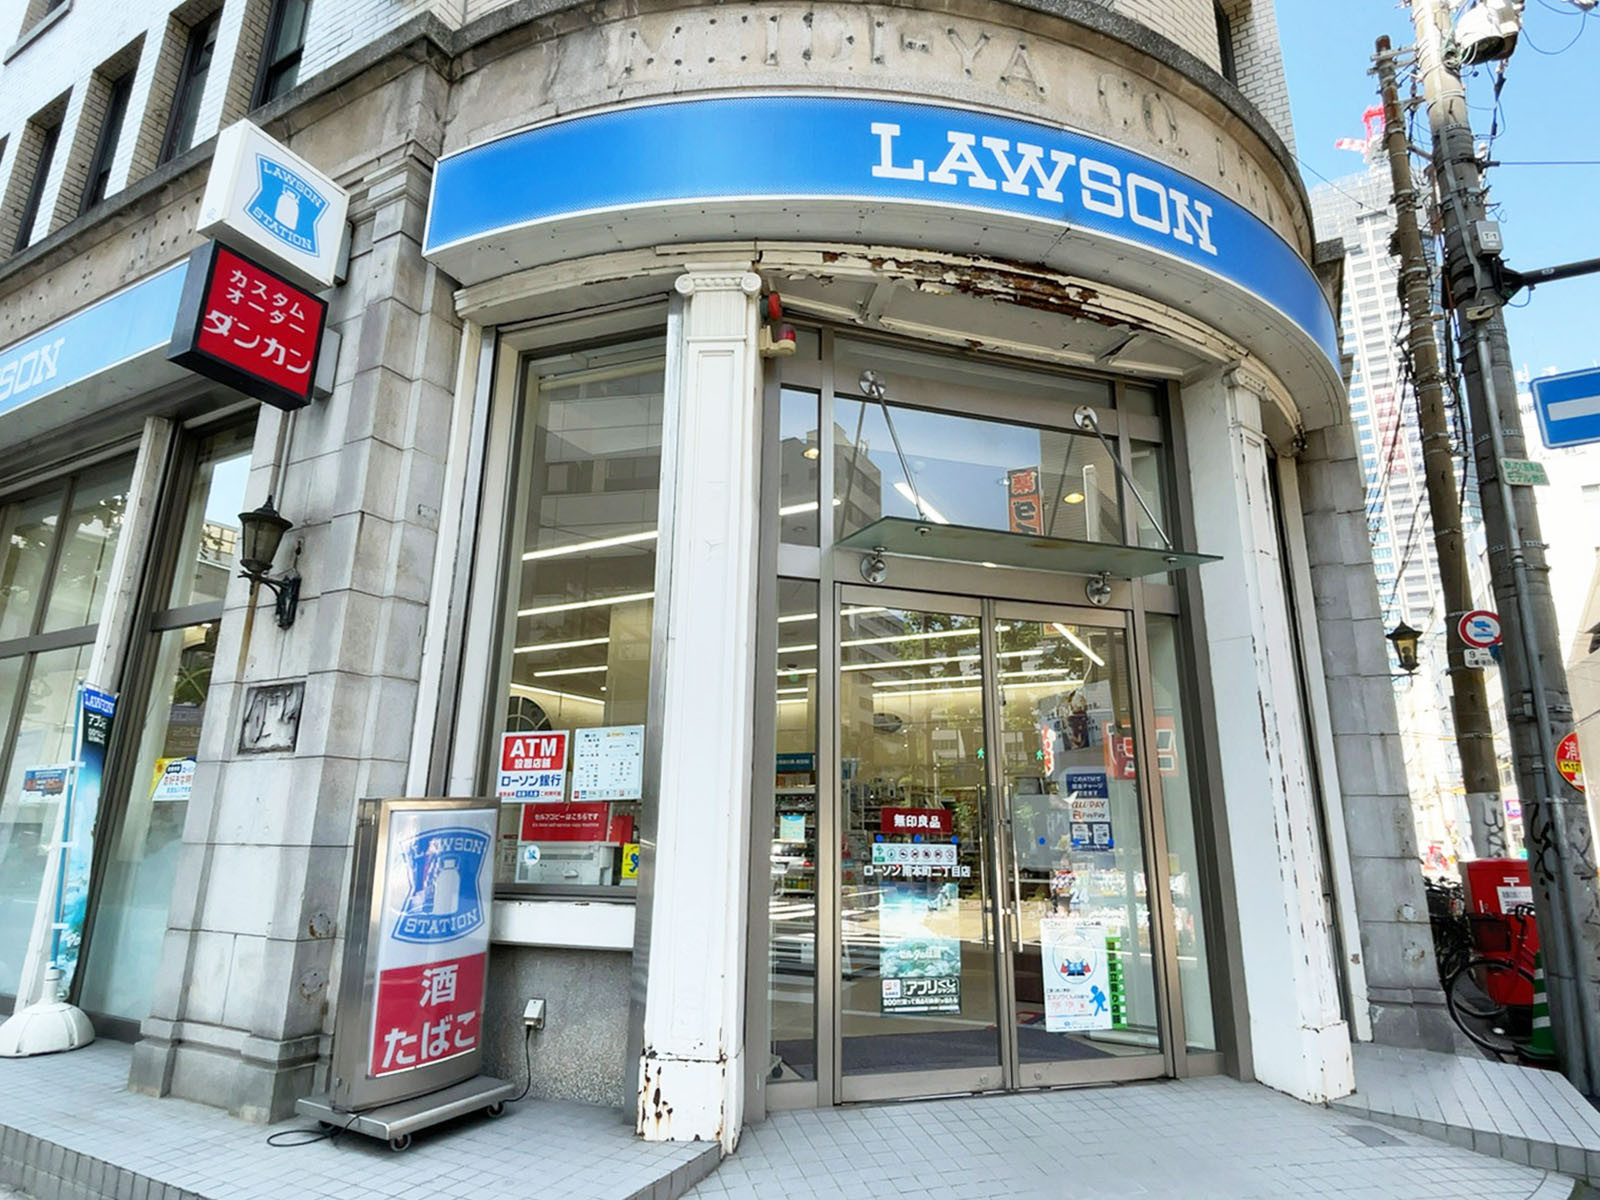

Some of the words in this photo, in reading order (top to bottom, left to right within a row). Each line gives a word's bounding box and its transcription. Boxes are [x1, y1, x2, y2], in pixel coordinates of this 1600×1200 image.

[261, 161, 325, 209] LAWSON
[870, 121, 1218, 257] LAWSON
[251, 207, 313, 252] STATION
[225, 286, 305, 335] オーダー
[230, 268, 305, 322] カスタム
[202, 309, 311, 375] ダンカン
[509, 738, 557, 758] ATM
[501, 774, 562, 787] ローソン銀行
[893, 813, 942, 829] 無印良品
[411, 834, 486, 861] LAWSON
[404, 908, 479, 935] STATION
[419, 963, 460, 1008] 酒
[380, 1010, 477, 1069] たばこ
